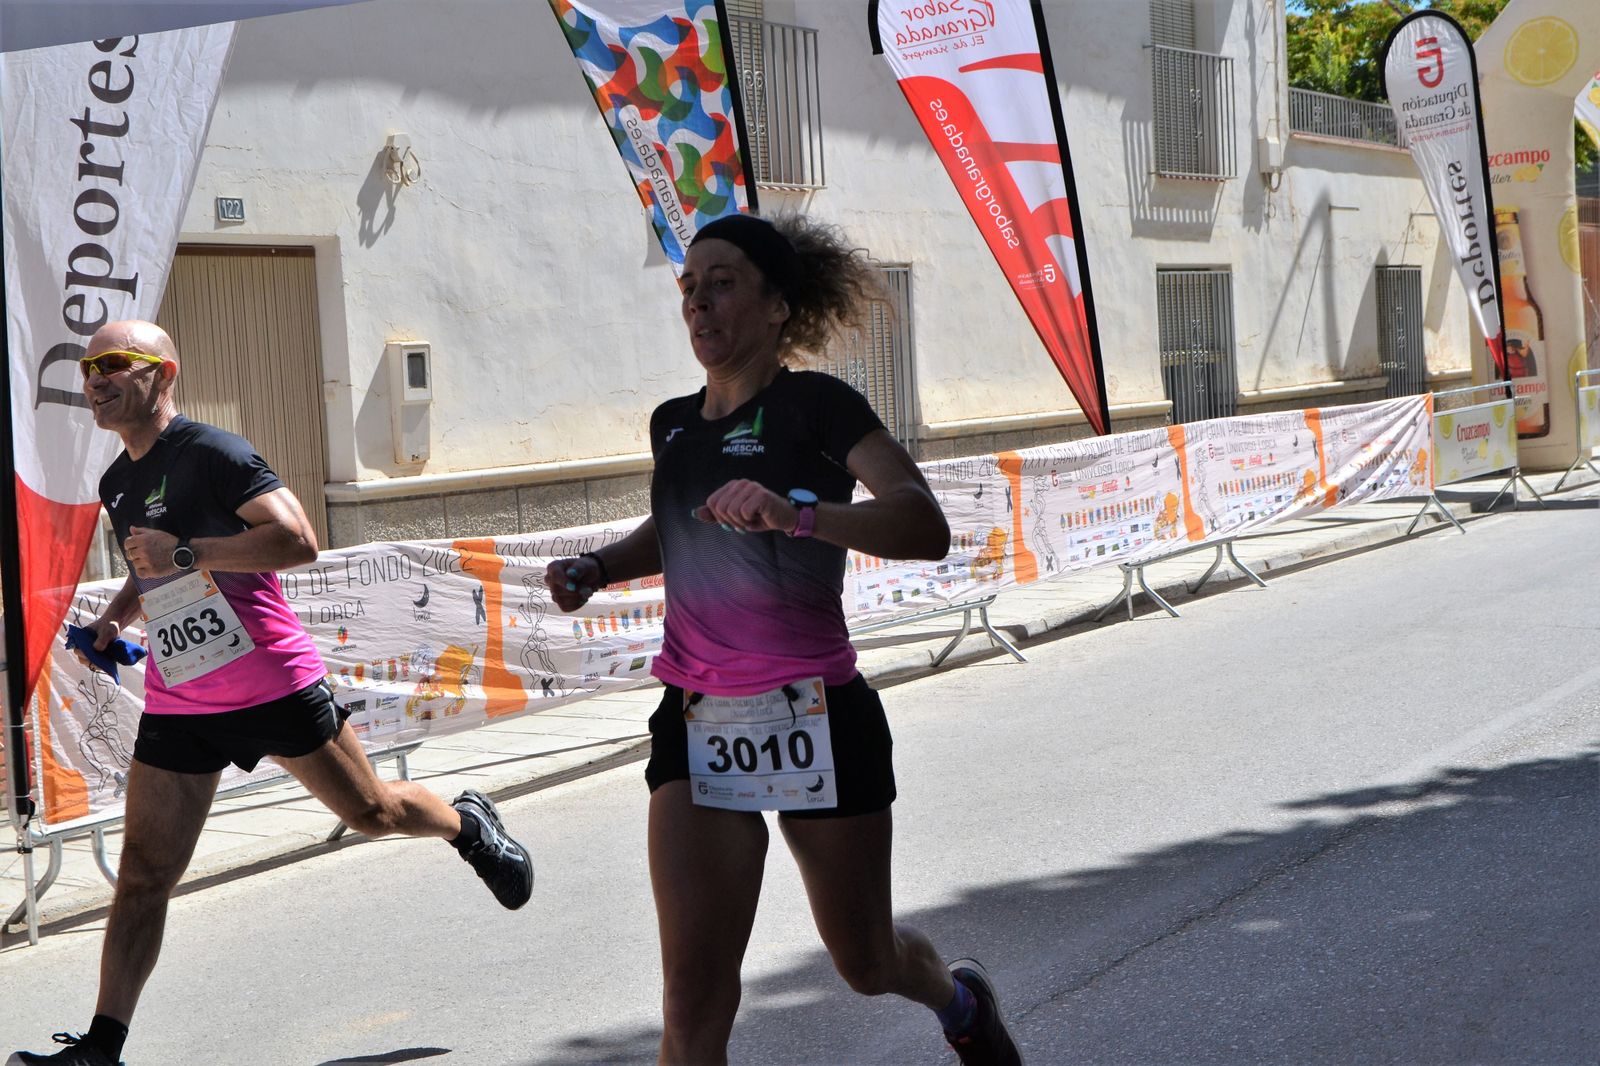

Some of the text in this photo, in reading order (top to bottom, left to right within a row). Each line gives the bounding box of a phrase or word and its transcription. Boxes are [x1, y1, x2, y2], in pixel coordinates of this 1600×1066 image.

[1487, 149, 1551, 168] zcampo
[222, 199, 242, 218] 122
[35, 34, 139, 410] Deportes
[1456, 421, 1491, 443] Cruzcampo
[937, 459, 974, 483] FONDO
[308, 565, 337, 596] DE
[345, 554, 413, 590] FONDO
[421, 547, 474, 578] 2022
[308, 600, 366, 626] LORCA
[157, 607, 226, 658] 3063
[707, 729, 814, 774] 3010
